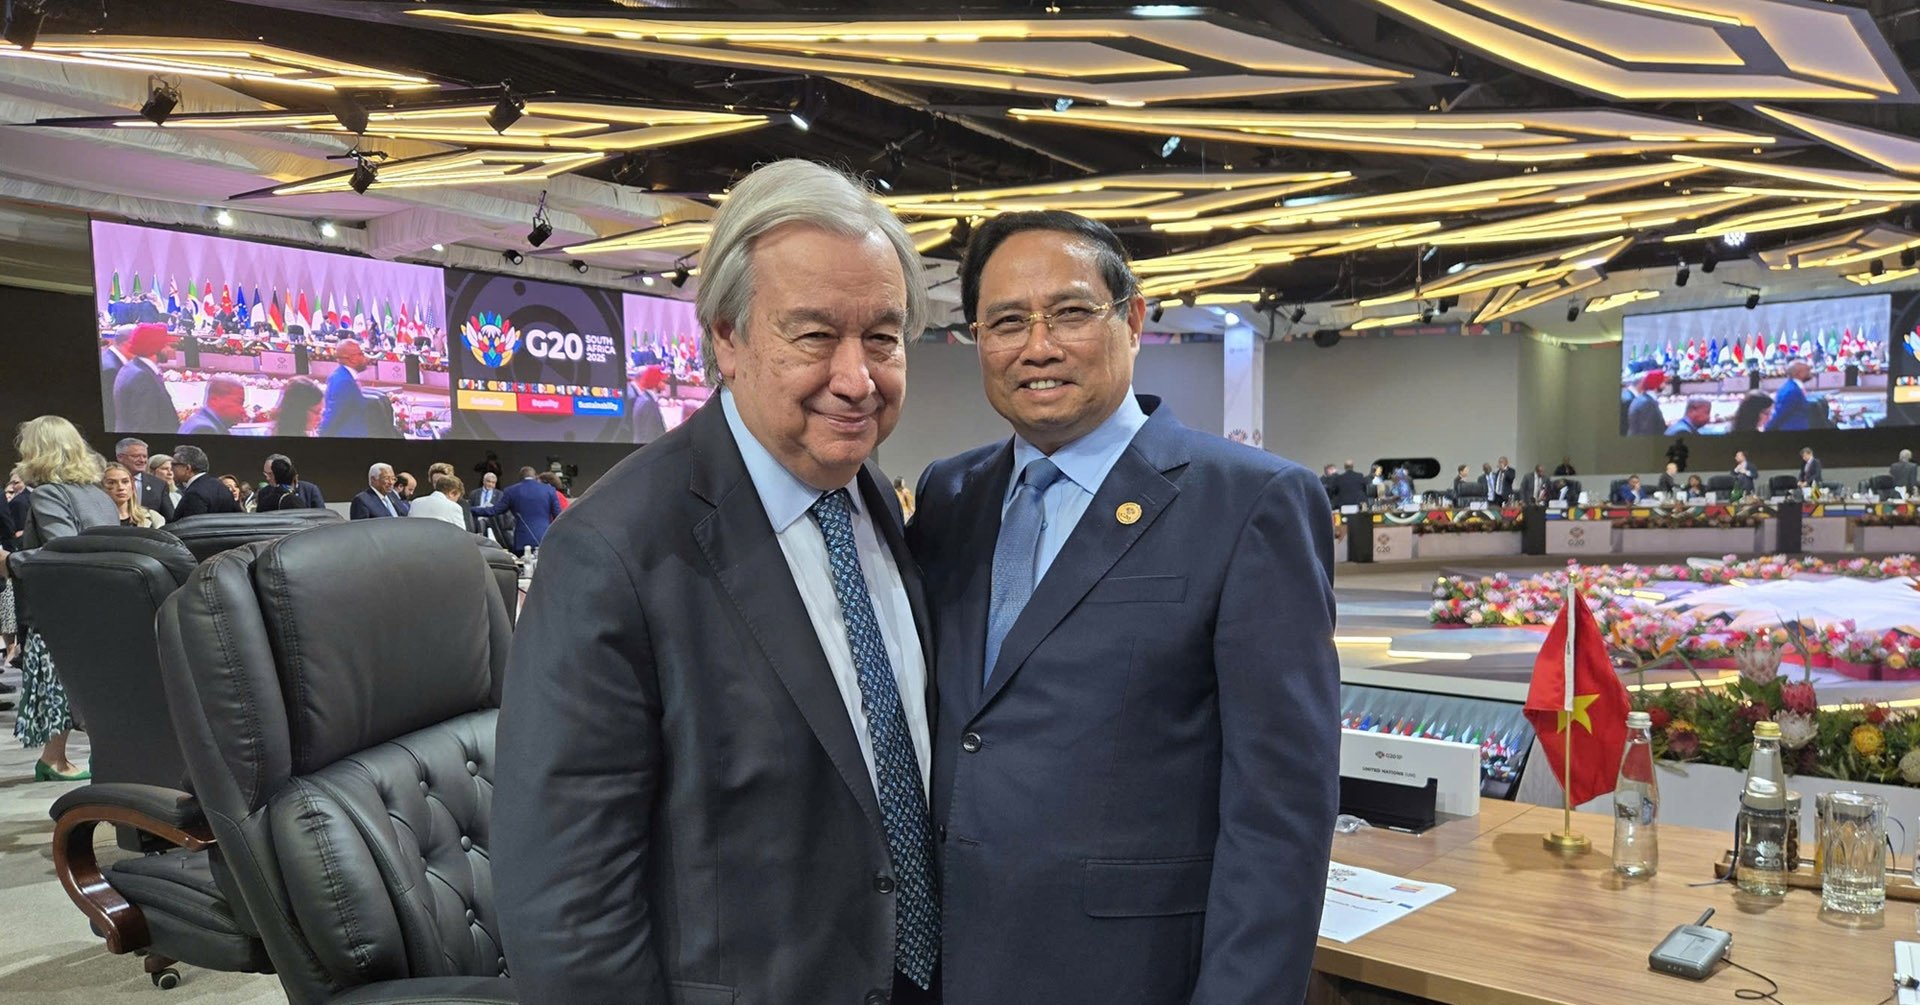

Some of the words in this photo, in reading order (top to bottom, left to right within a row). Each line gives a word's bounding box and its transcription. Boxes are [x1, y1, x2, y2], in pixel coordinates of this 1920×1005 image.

[526, 329, 583, 360] G20
[585, 335, 613, 345] SOUTH
[586, 345, 616, 355] AFRICA
[586, 352, 606, 362] 2025
[531, 399, 559, 408] Equality
[578, 401, 618, 410] Sustainability
[1755, 857, 1780, 867] G20
